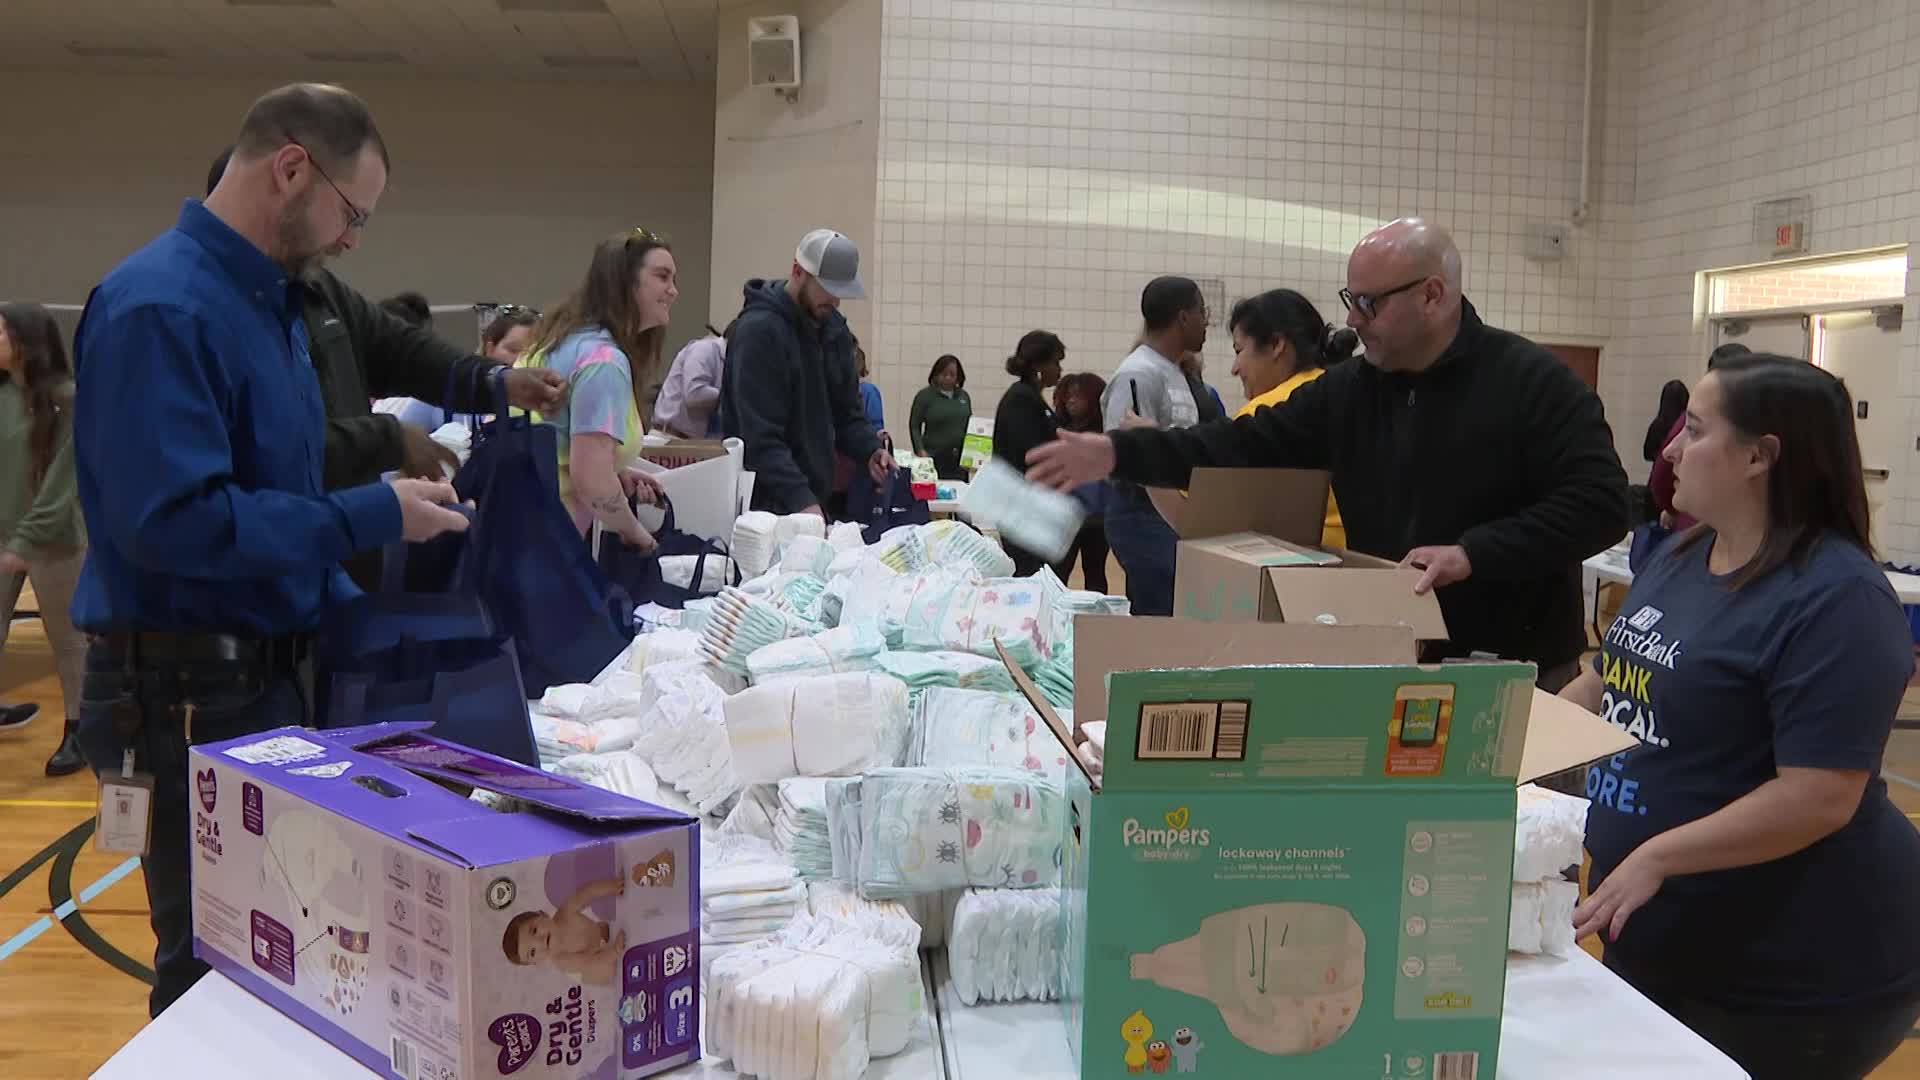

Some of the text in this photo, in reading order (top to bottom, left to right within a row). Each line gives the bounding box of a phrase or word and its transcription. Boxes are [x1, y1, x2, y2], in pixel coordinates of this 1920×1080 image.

[1605, 615, 1682, 670] FirstBank
[1602, 650, 1654, 704] BANK
[1598, 691, 1671, 748] OCAL.
[1585, 766, 1648, 816] ORE.
[1122, 816, 1211, 849] Pampers
[1218, 847, 1281, 861] lockaway
[586, 999, 597, 1044] Diapers
[669, 985, 693, 1010] 3
[545, 996, 568, 1066] Dry &
[564, 985, 583, 1066] Gentle
